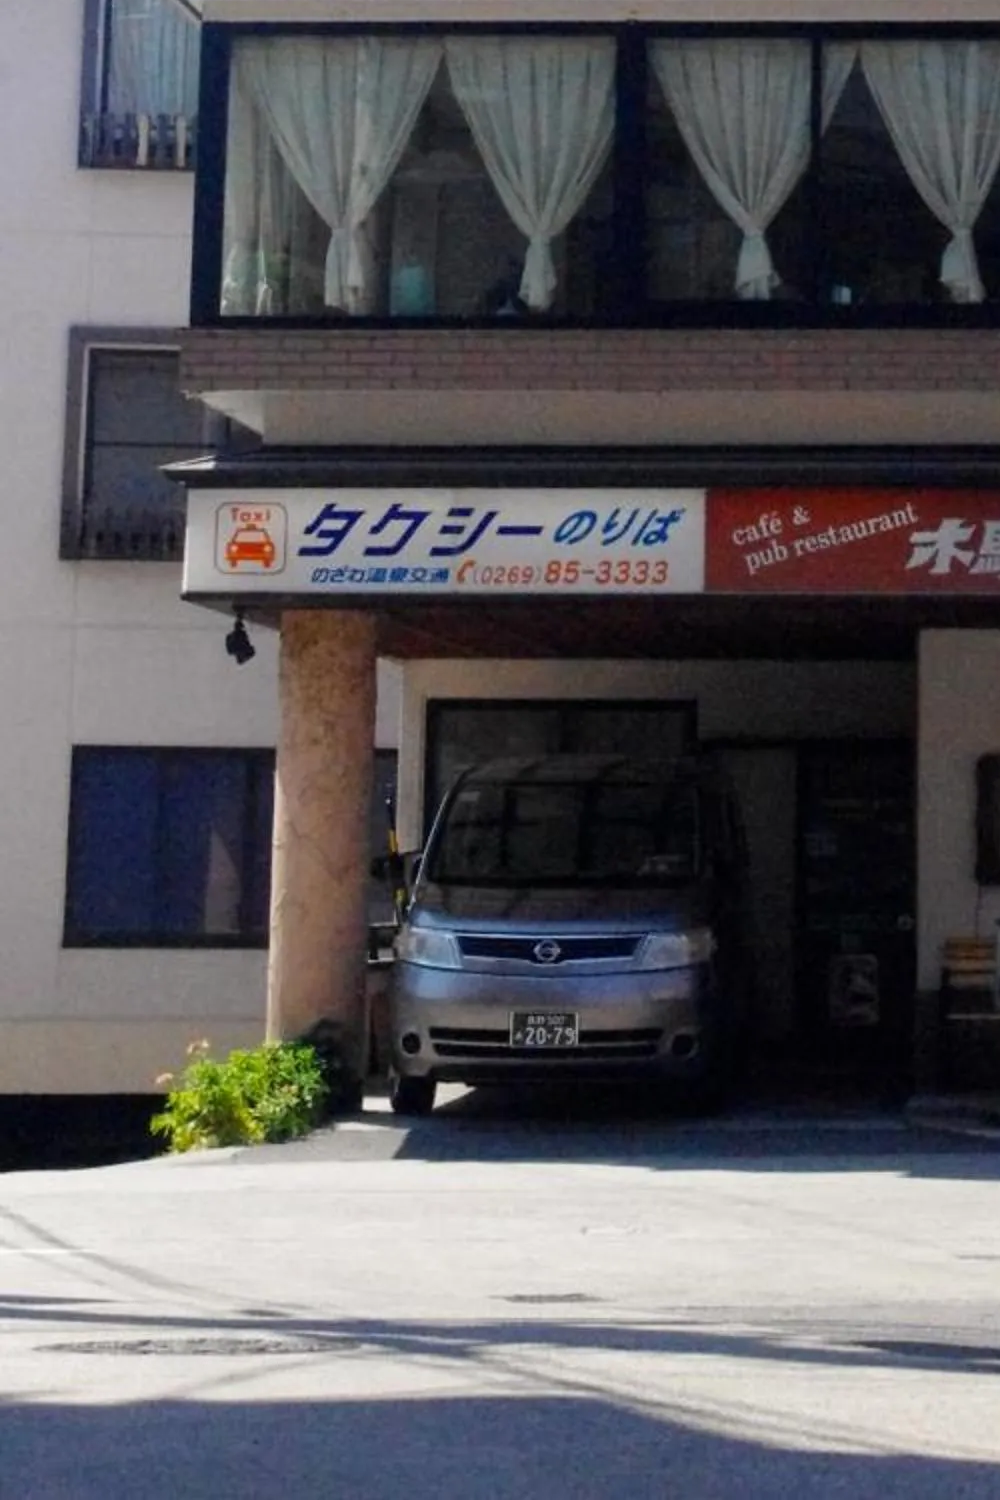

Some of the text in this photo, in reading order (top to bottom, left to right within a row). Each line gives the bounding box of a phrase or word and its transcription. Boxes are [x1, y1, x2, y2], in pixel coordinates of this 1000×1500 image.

[230, 506, 270, 523] Taxi
[297, 503, 686, 557] タクシーのりば
[731, 503, 812, 546] café &
[744, 502, 920, 575] pub restaurant
